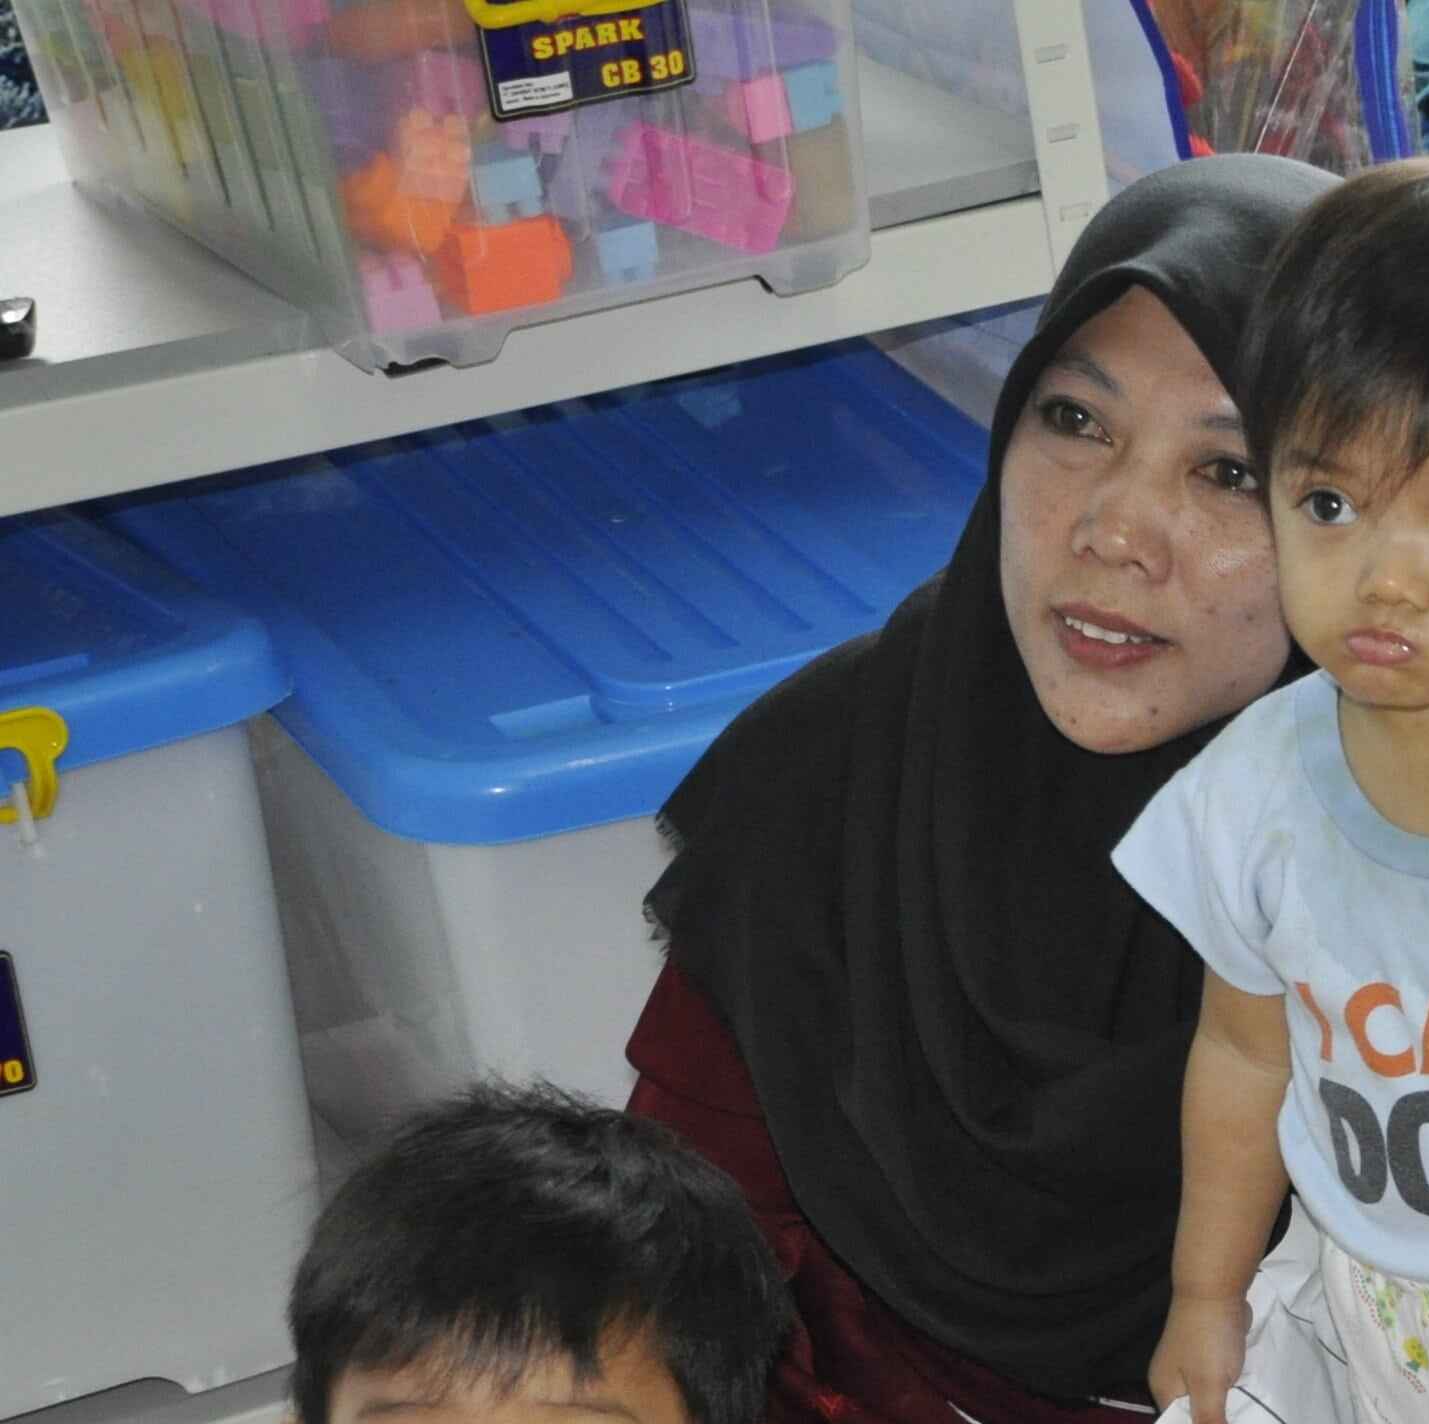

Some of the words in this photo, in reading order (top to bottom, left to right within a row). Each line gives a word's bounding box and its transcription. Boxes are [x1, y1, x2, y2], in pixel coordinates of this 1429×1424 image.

[531, 18, 645, 60] SPARK
[601, 59, 642, 88] CB
[649, 50, 685, 80] 30
[1295, 981, 1333, 1063] I
[0, 1058, 25, 1084] 0
